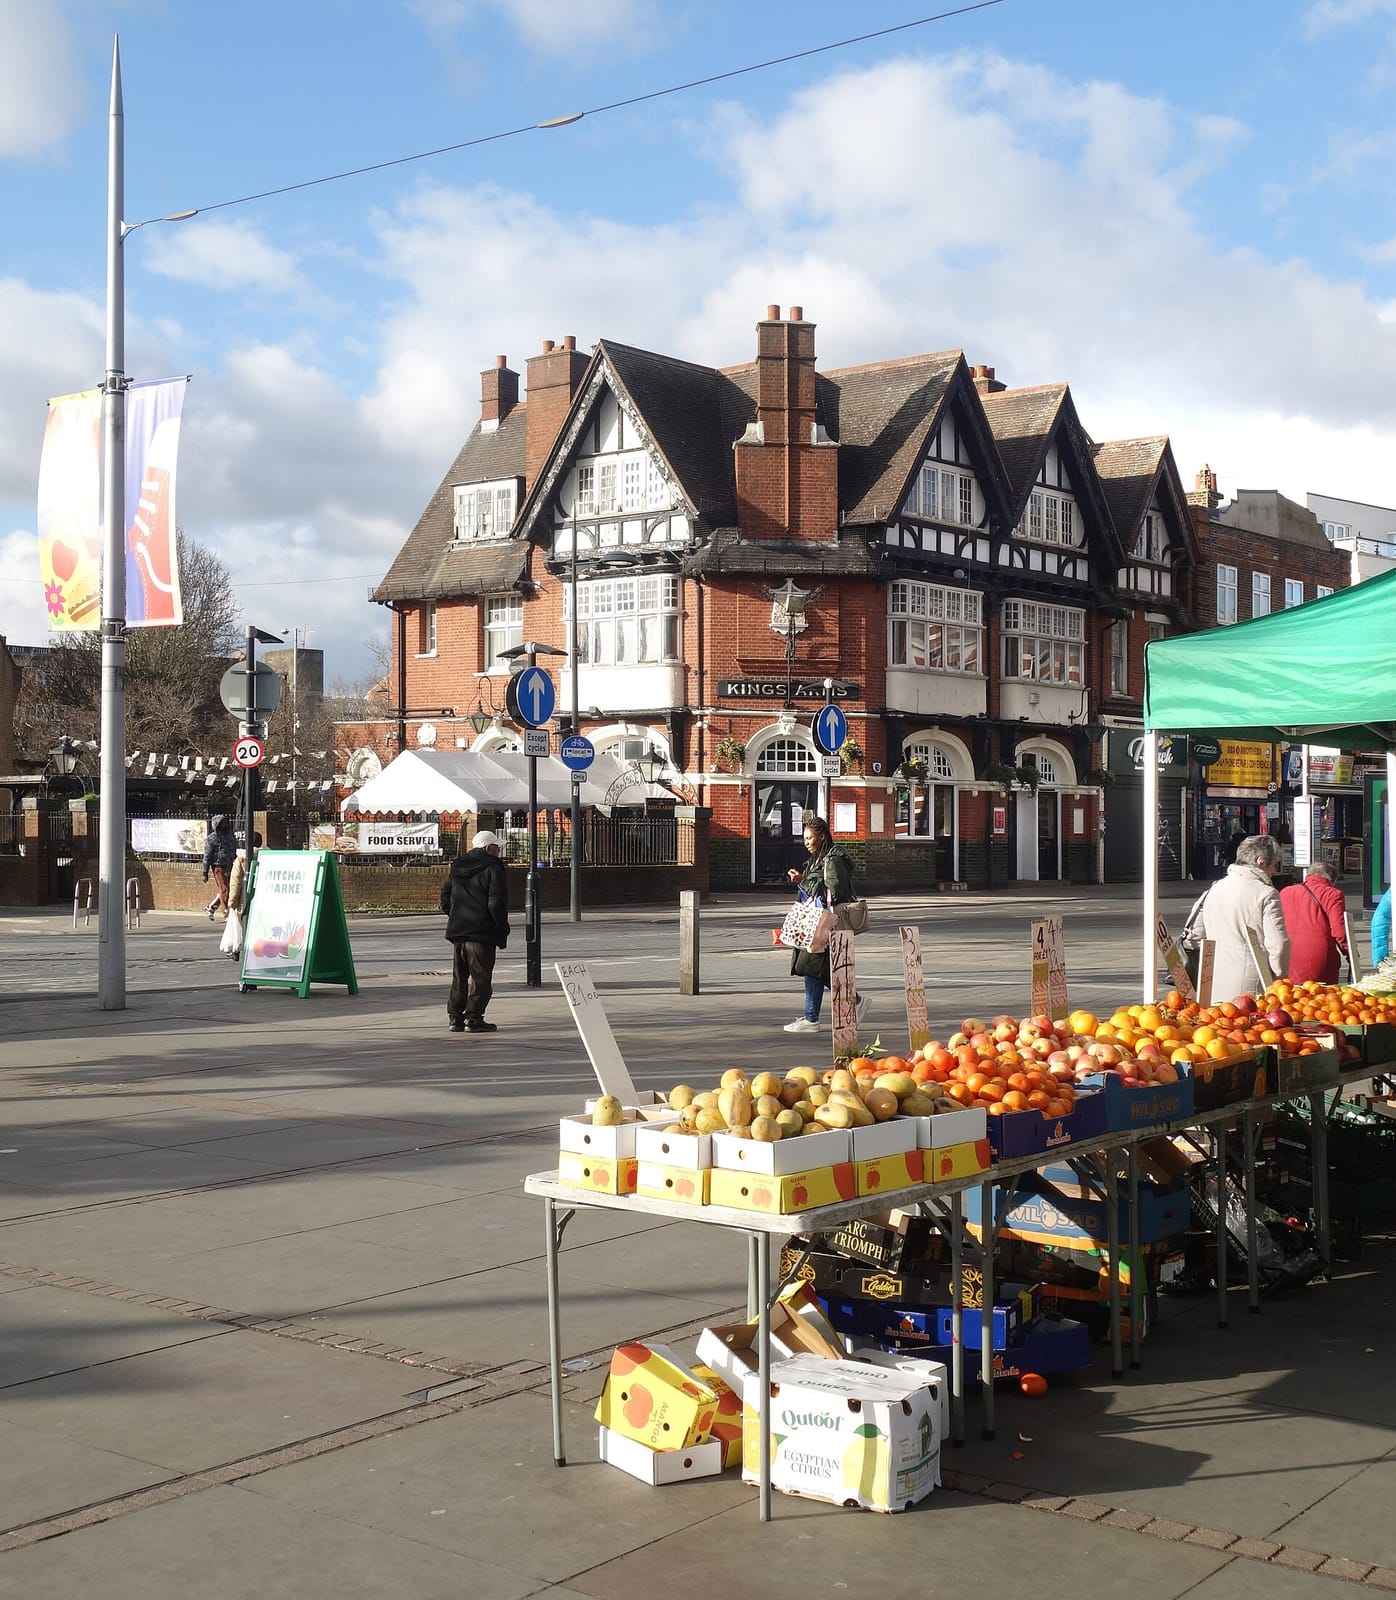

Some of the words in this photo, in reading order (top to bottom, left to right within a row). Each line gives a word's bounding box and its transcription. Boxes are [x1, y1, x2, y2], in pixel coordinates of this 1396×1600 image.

[727, 683, 787, 696] KINGS
[527, 733, 547, 742] Except
[238, 746, 259, 760] 20
[527, 744, 546, 753] cycles
[823, 758, 839, 767] Except
[368, 836, 394, 845] FOOD
[397, 836, 434, 845] SERVED
[266, 883, 304, 894] ARKE
[1037, 926, 1045, 949] 4
[561, 963, 587, 978] EACH
[790, 1175, 807, 1183] MANGO
[844, 1220, 868, 1239] ARC
[833, 1231, 890, 1262] TRIOMPHE
[650, 1401, 669, 1444] MANGO
[784, 1449, 841, 1470] EGYPTIAN
[790, 1462, 832, 1479] CITRUS
